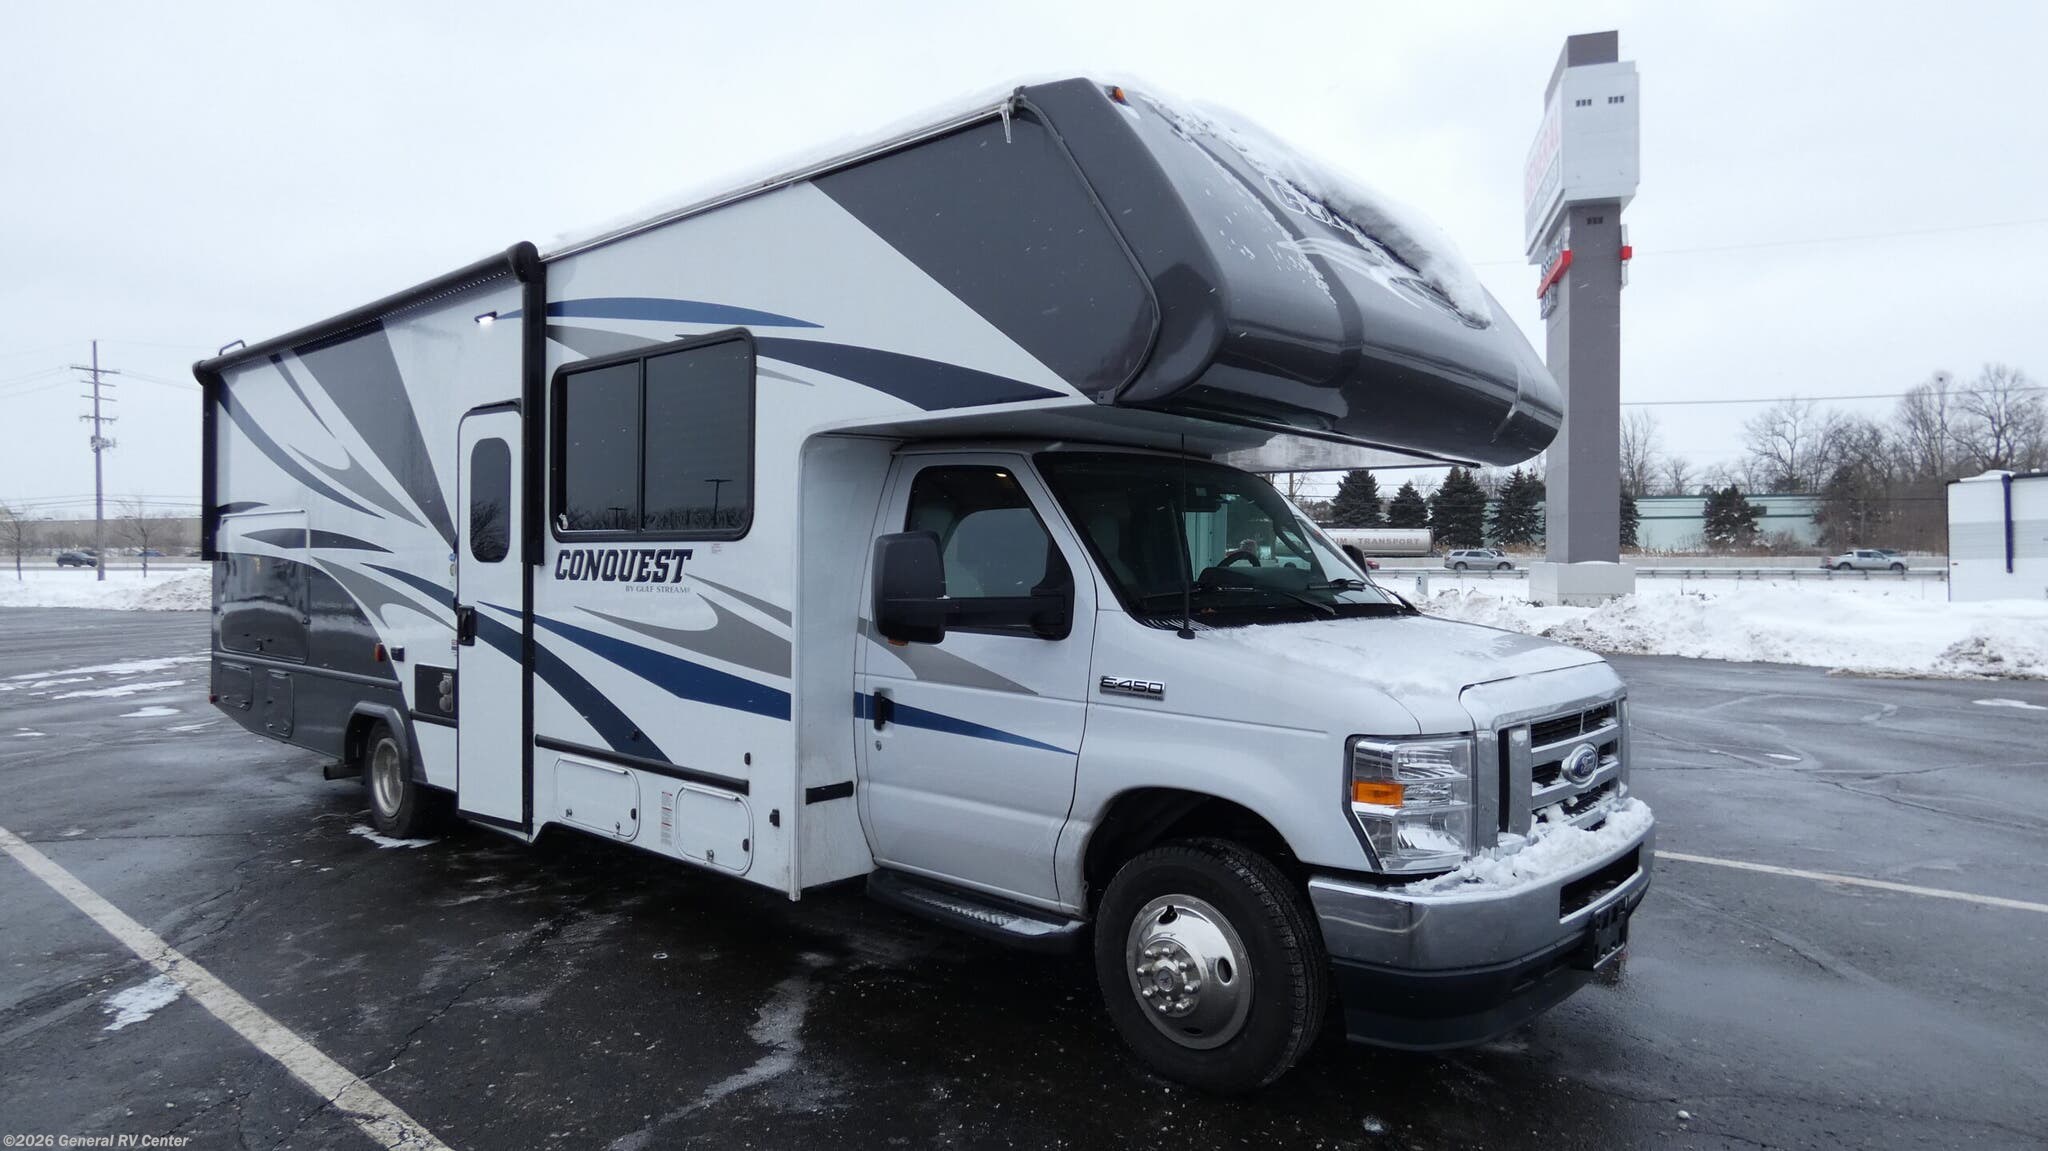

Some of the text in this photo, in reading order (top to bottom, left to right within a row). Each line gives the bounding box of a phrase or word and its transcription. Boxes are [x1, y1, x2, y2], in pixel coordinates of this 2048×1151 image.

[1358, 537, 1420, 545] TRANSPORT
[554, 548, 693, 583] CONQUEST
[636, 585, 653, 593] GULF
